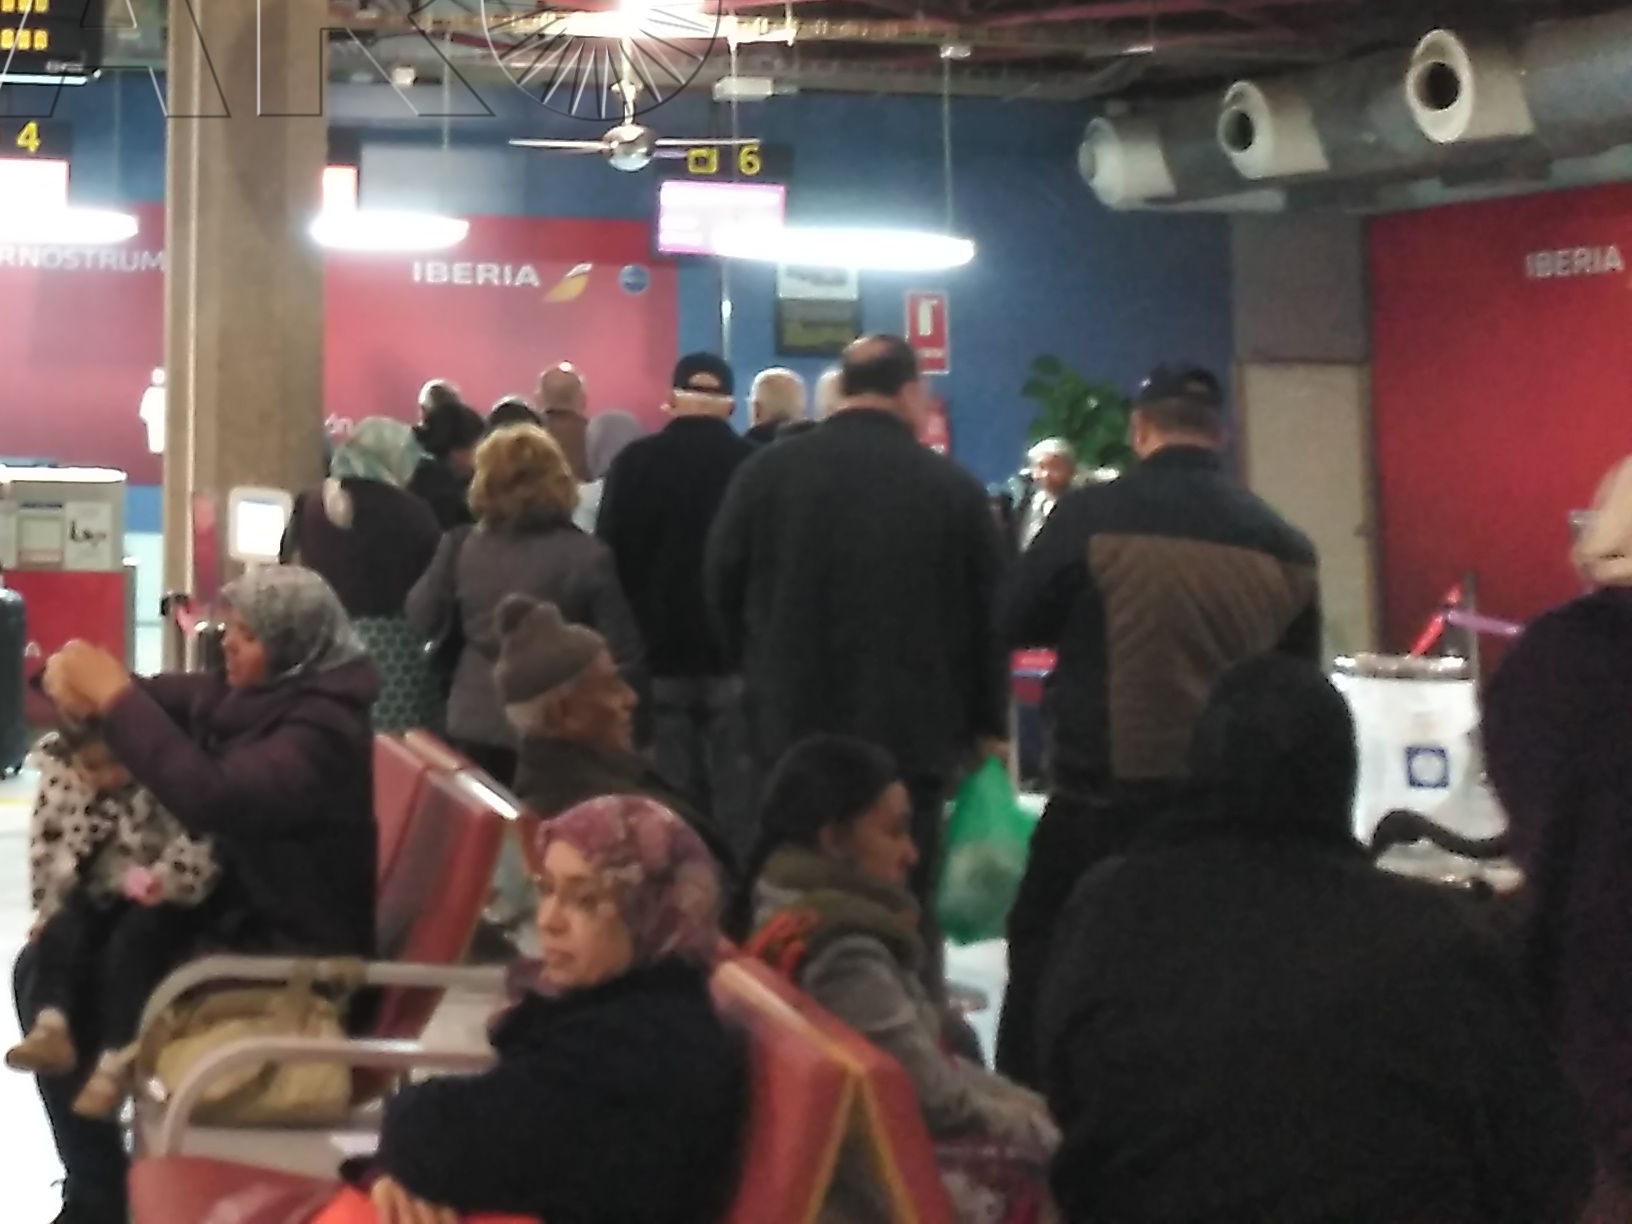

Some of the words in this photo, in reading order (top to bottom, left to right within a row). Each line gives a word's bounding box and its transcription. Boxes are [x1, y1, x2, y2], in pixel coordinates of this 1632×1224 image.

[15, 120, 42, 153] 4
[738, 143, 760, 176] 6
[411, 260, 542, 288] IBERIA
[1525, 245, 1626, 278] IBERIA
